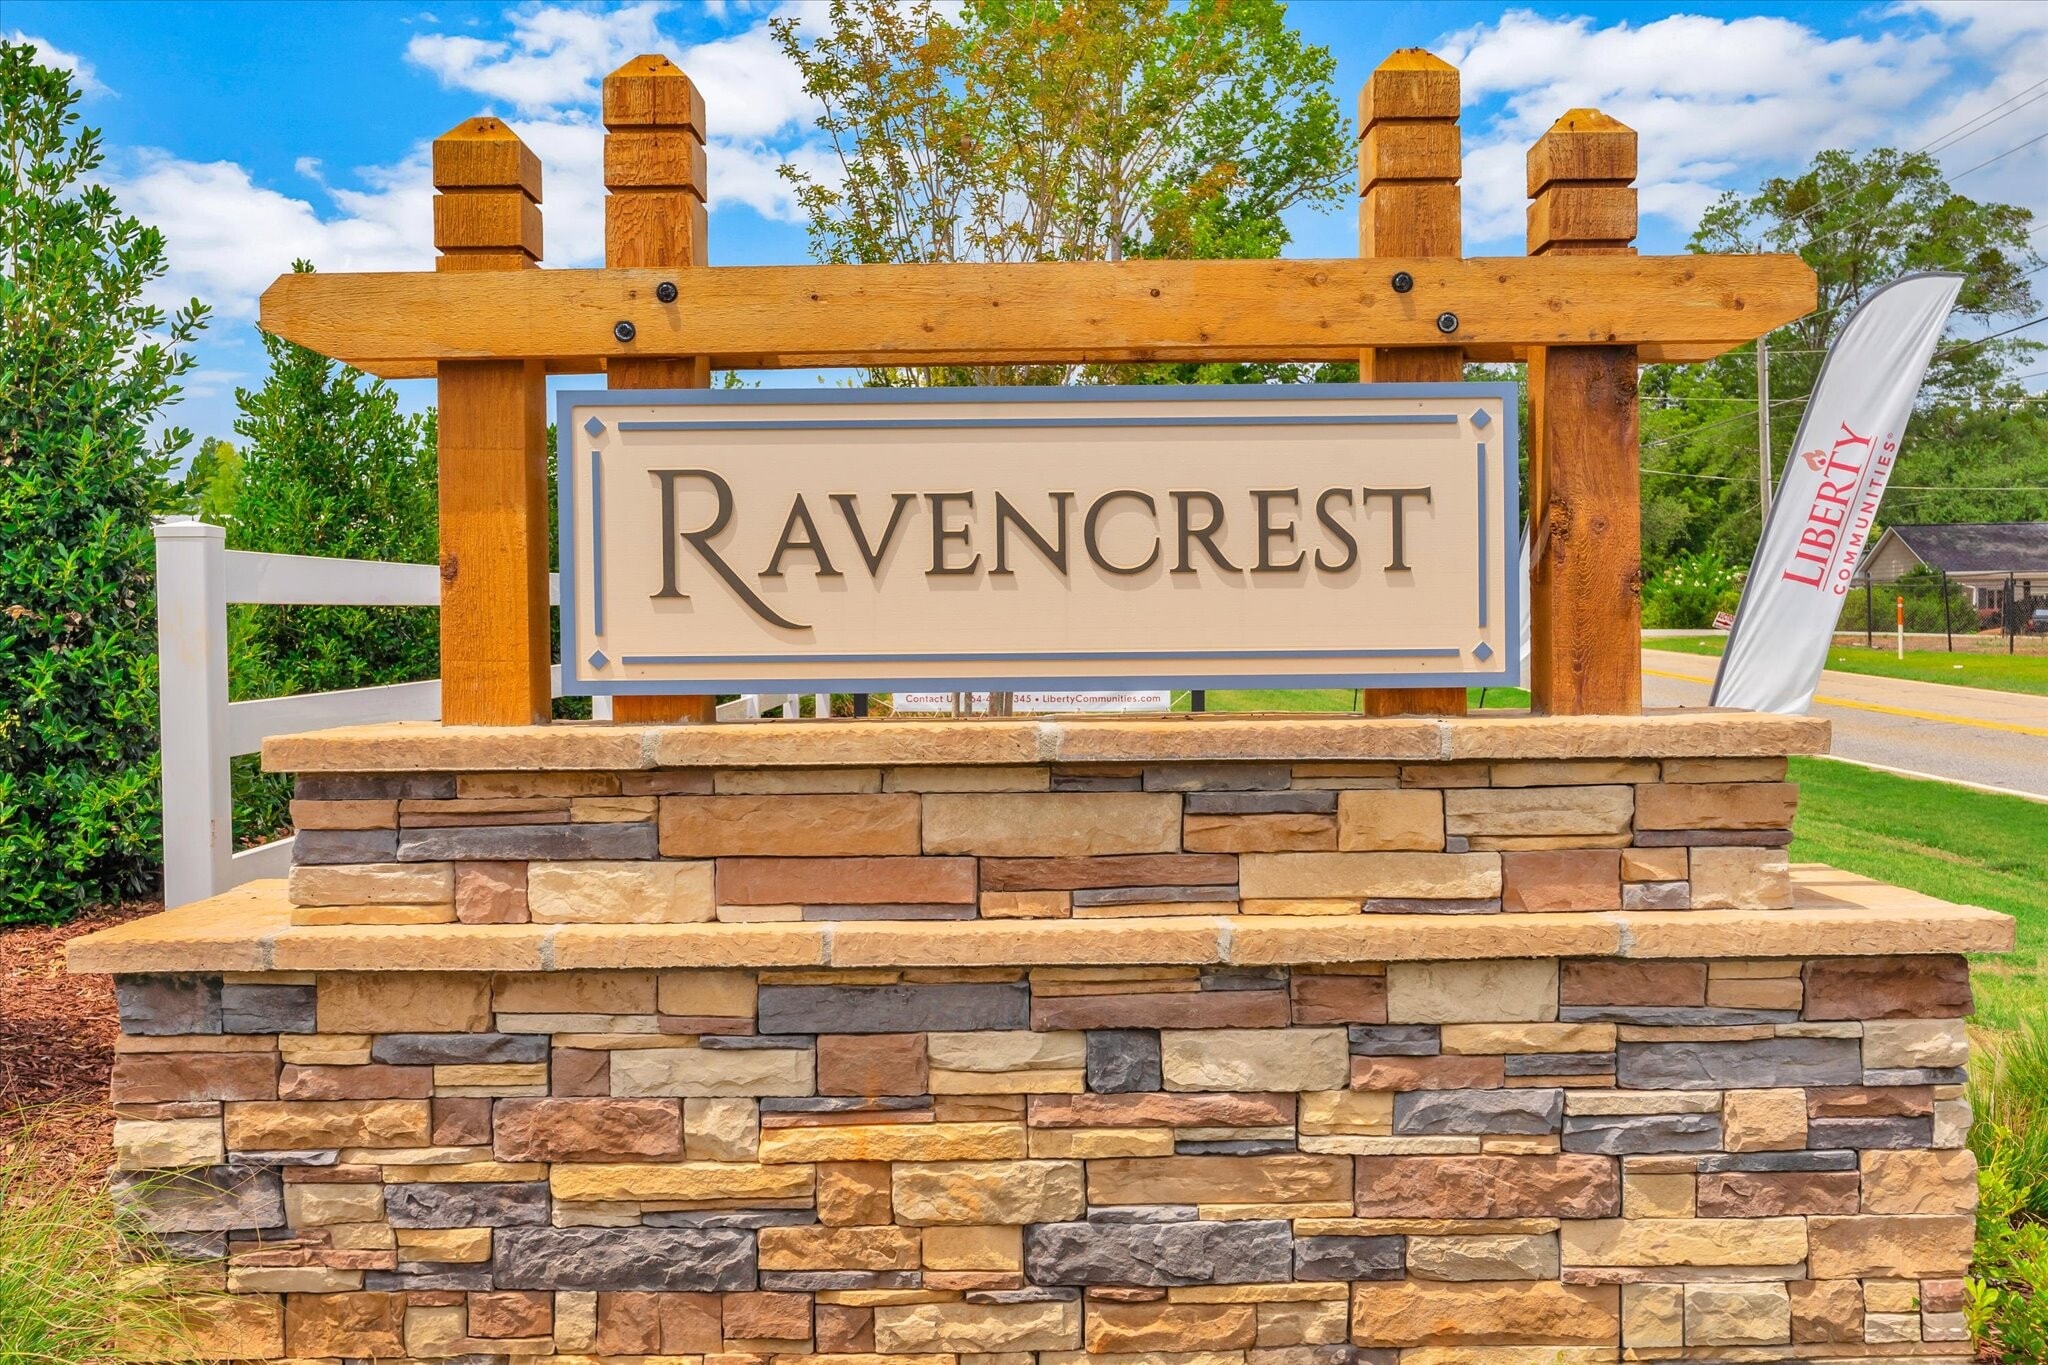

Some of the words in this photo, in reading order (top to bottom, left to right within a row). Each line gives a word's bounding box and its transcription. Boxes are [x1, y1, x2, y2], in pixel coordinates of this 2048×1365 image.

[646, 467, 1433, 630] RAVENCREST
[1781, 420, 1873, 590] LIBERTY
[905, 694, 943, 703] Contact
[1042, 694, 1161, 705] LibertyCommunities.com
